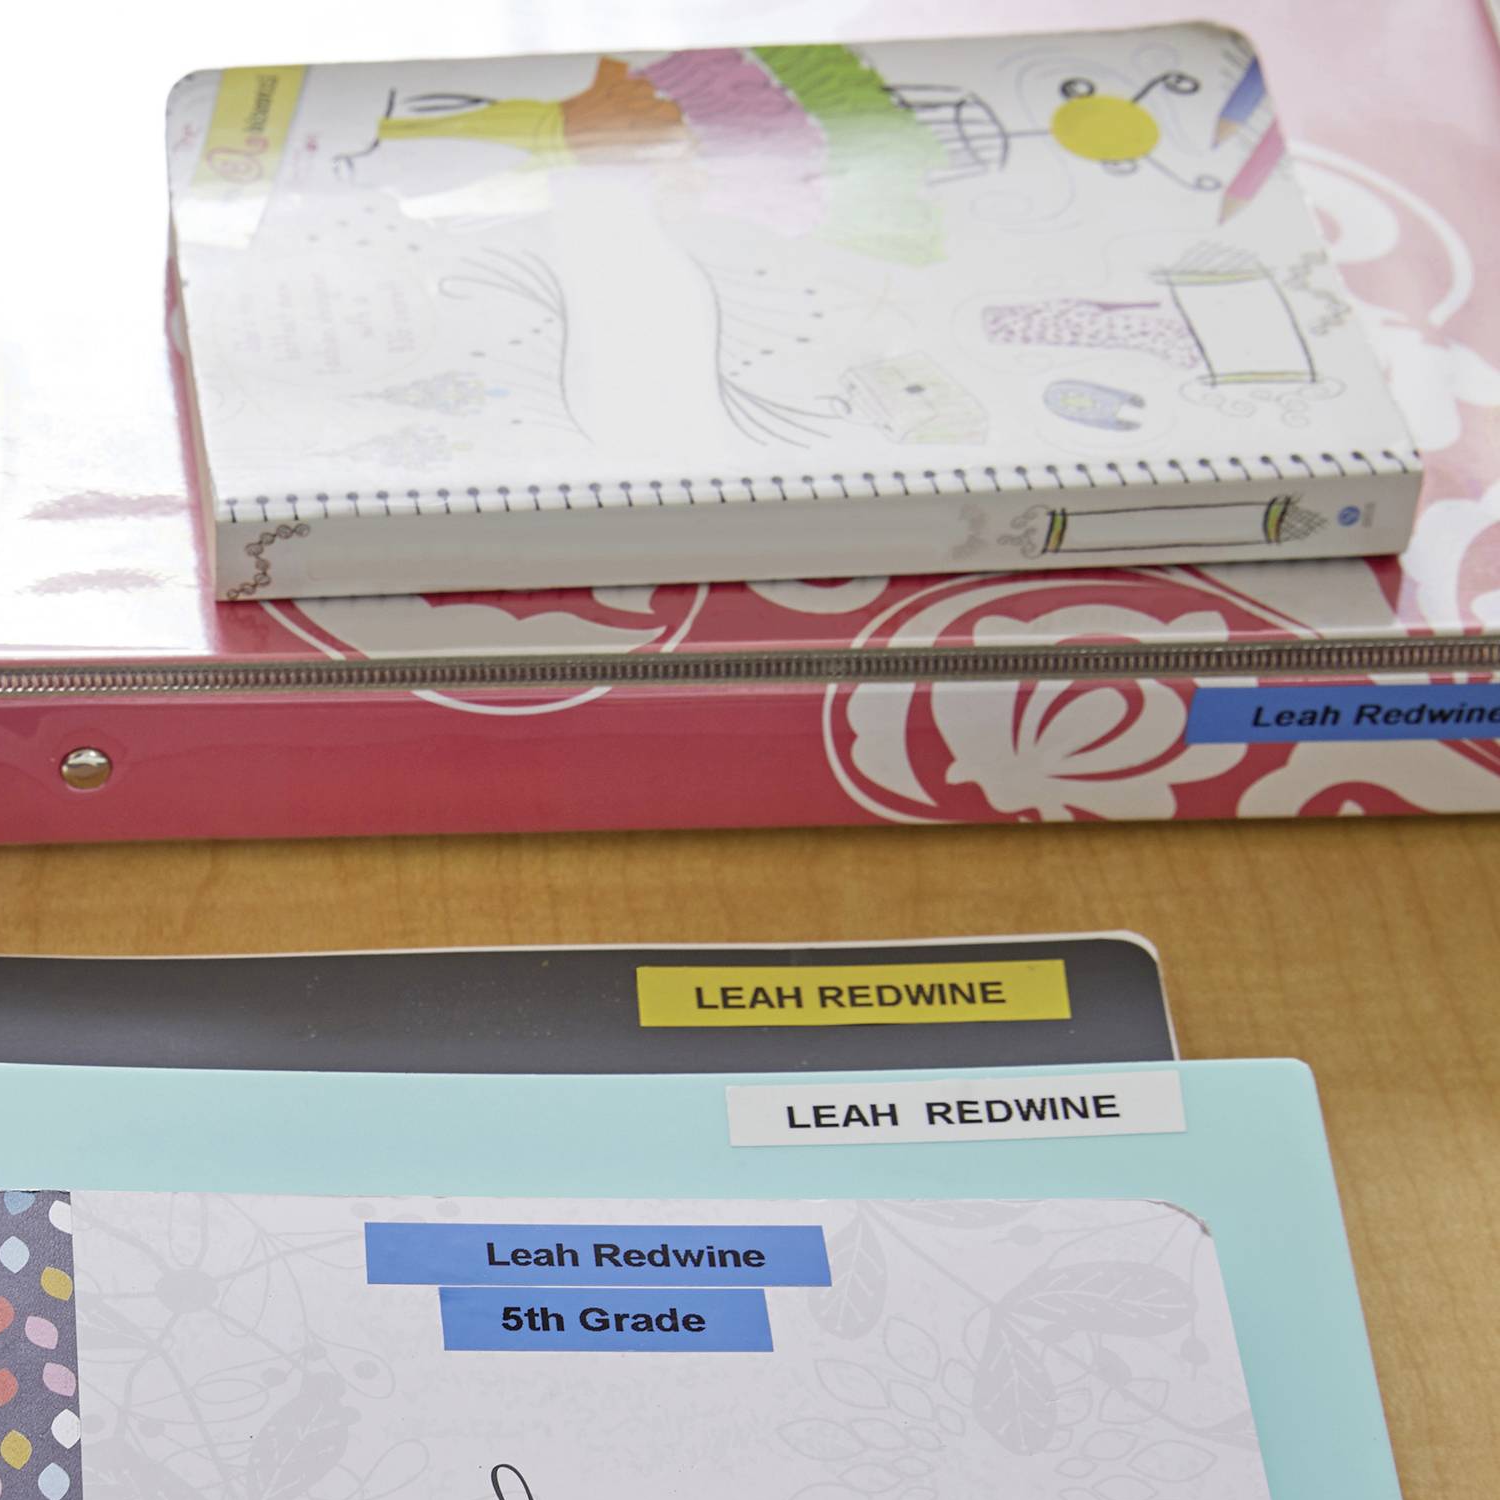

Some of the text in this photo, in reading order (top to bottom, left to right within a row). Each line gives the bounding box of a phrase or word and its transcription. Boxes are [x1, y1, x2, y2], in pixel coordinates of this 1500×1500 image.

[1252, 702, 1500, 728] Leah Redwine
[693, 980, 1007, 1011] LEAH REDWINE
[786, 1093, 1121, 1130] LEAH REDWINE
[484, 1241, 767, 1269] Leah Redwine
[500, 1305, 707, 1333] 5th Grade
